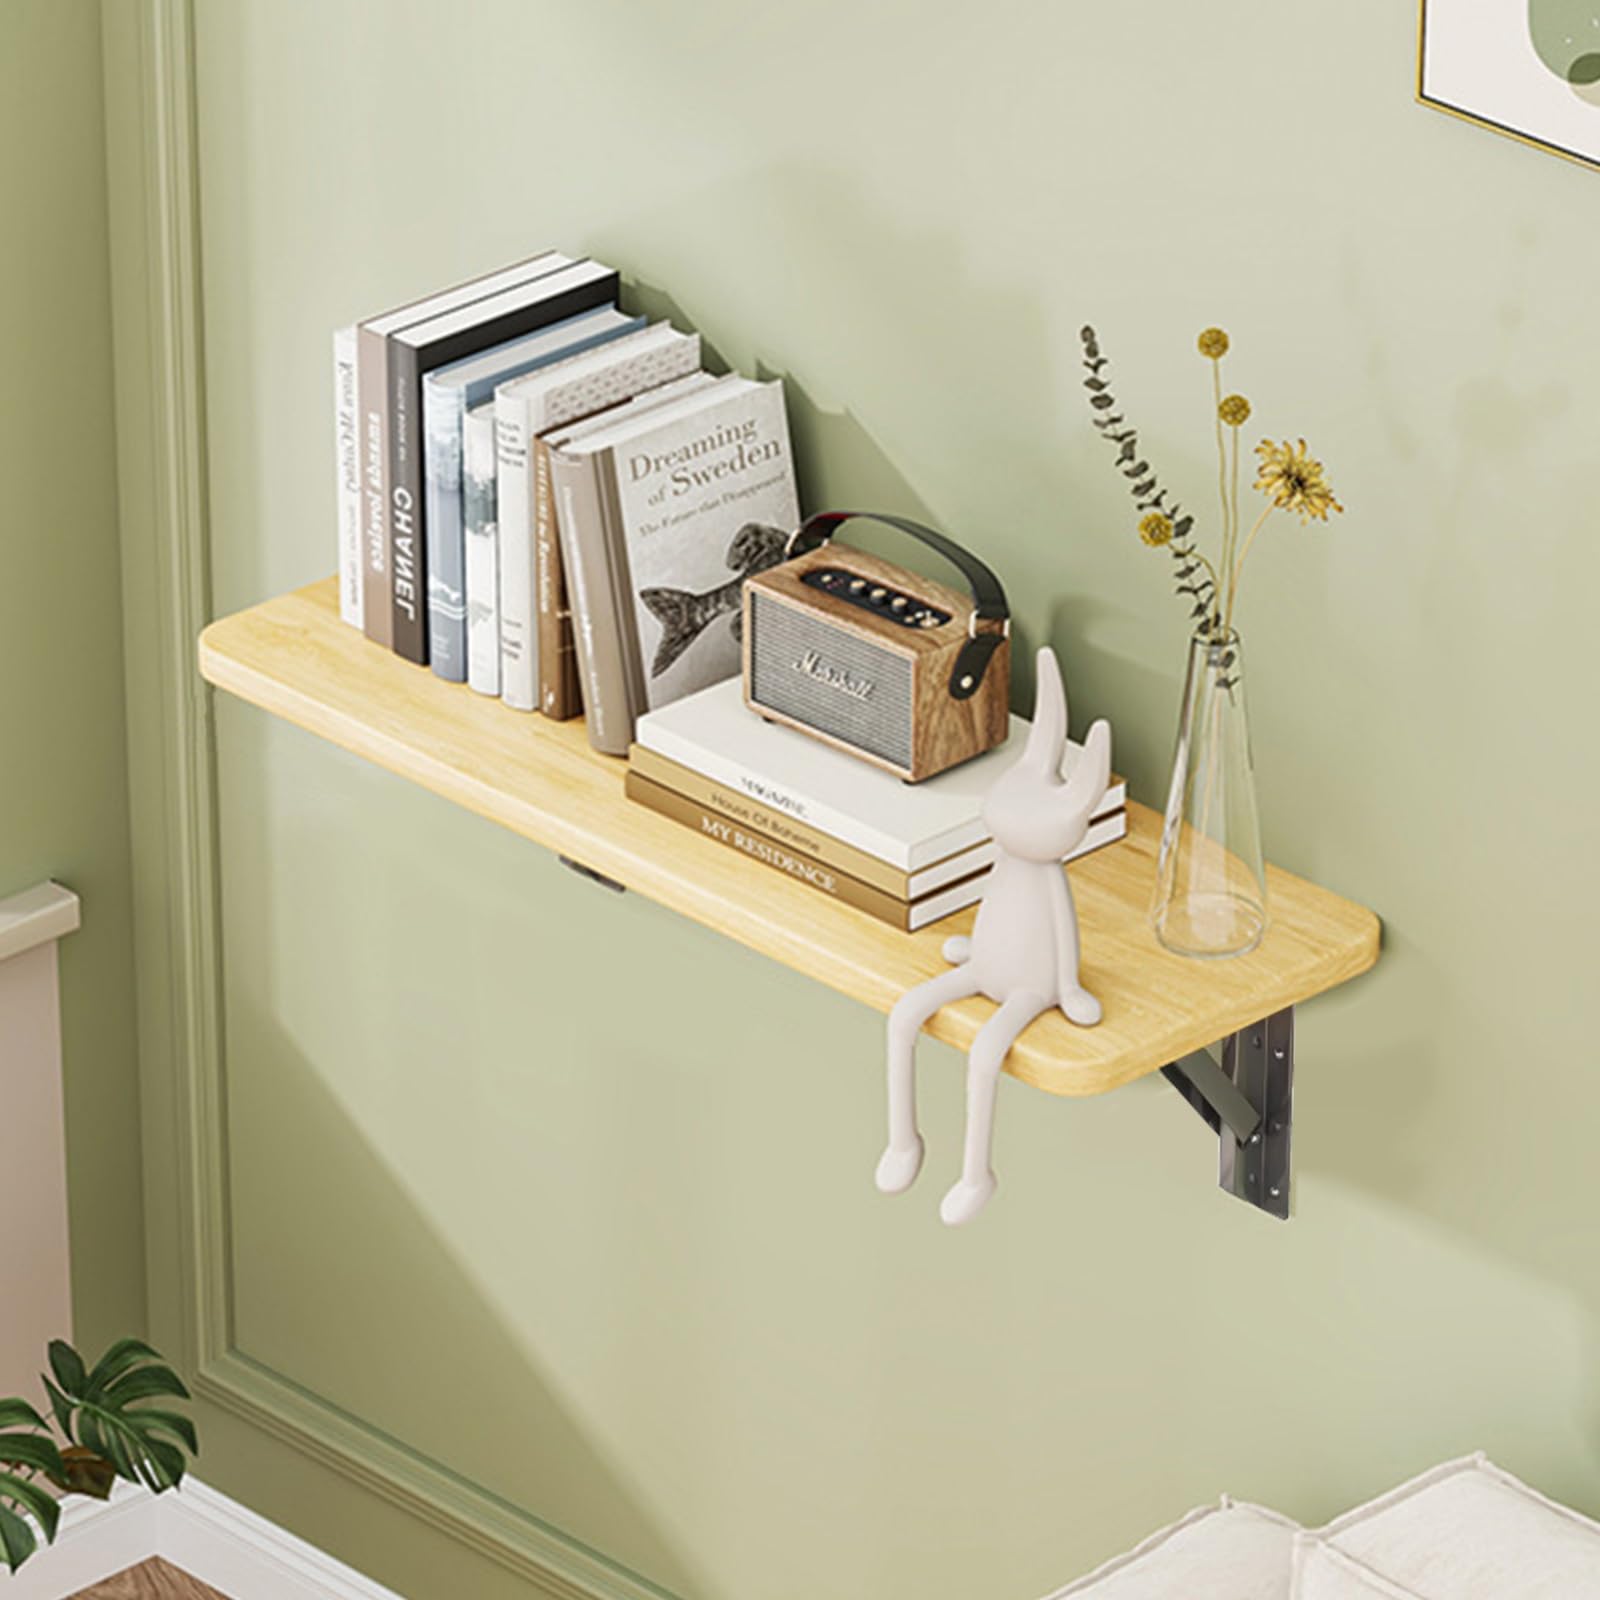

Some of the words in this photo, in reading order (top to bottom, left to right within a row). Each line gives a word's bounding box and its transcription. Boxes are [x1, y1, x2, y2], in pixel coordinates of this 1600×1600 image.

[629, 418, 758, 482] Dreaming
[647, 483, 665, 507] of
[670, 439, 782, 497] Sweden
[701, 815, 731, 842] MY
[733, 831, 838, 893] RESIDENCE
